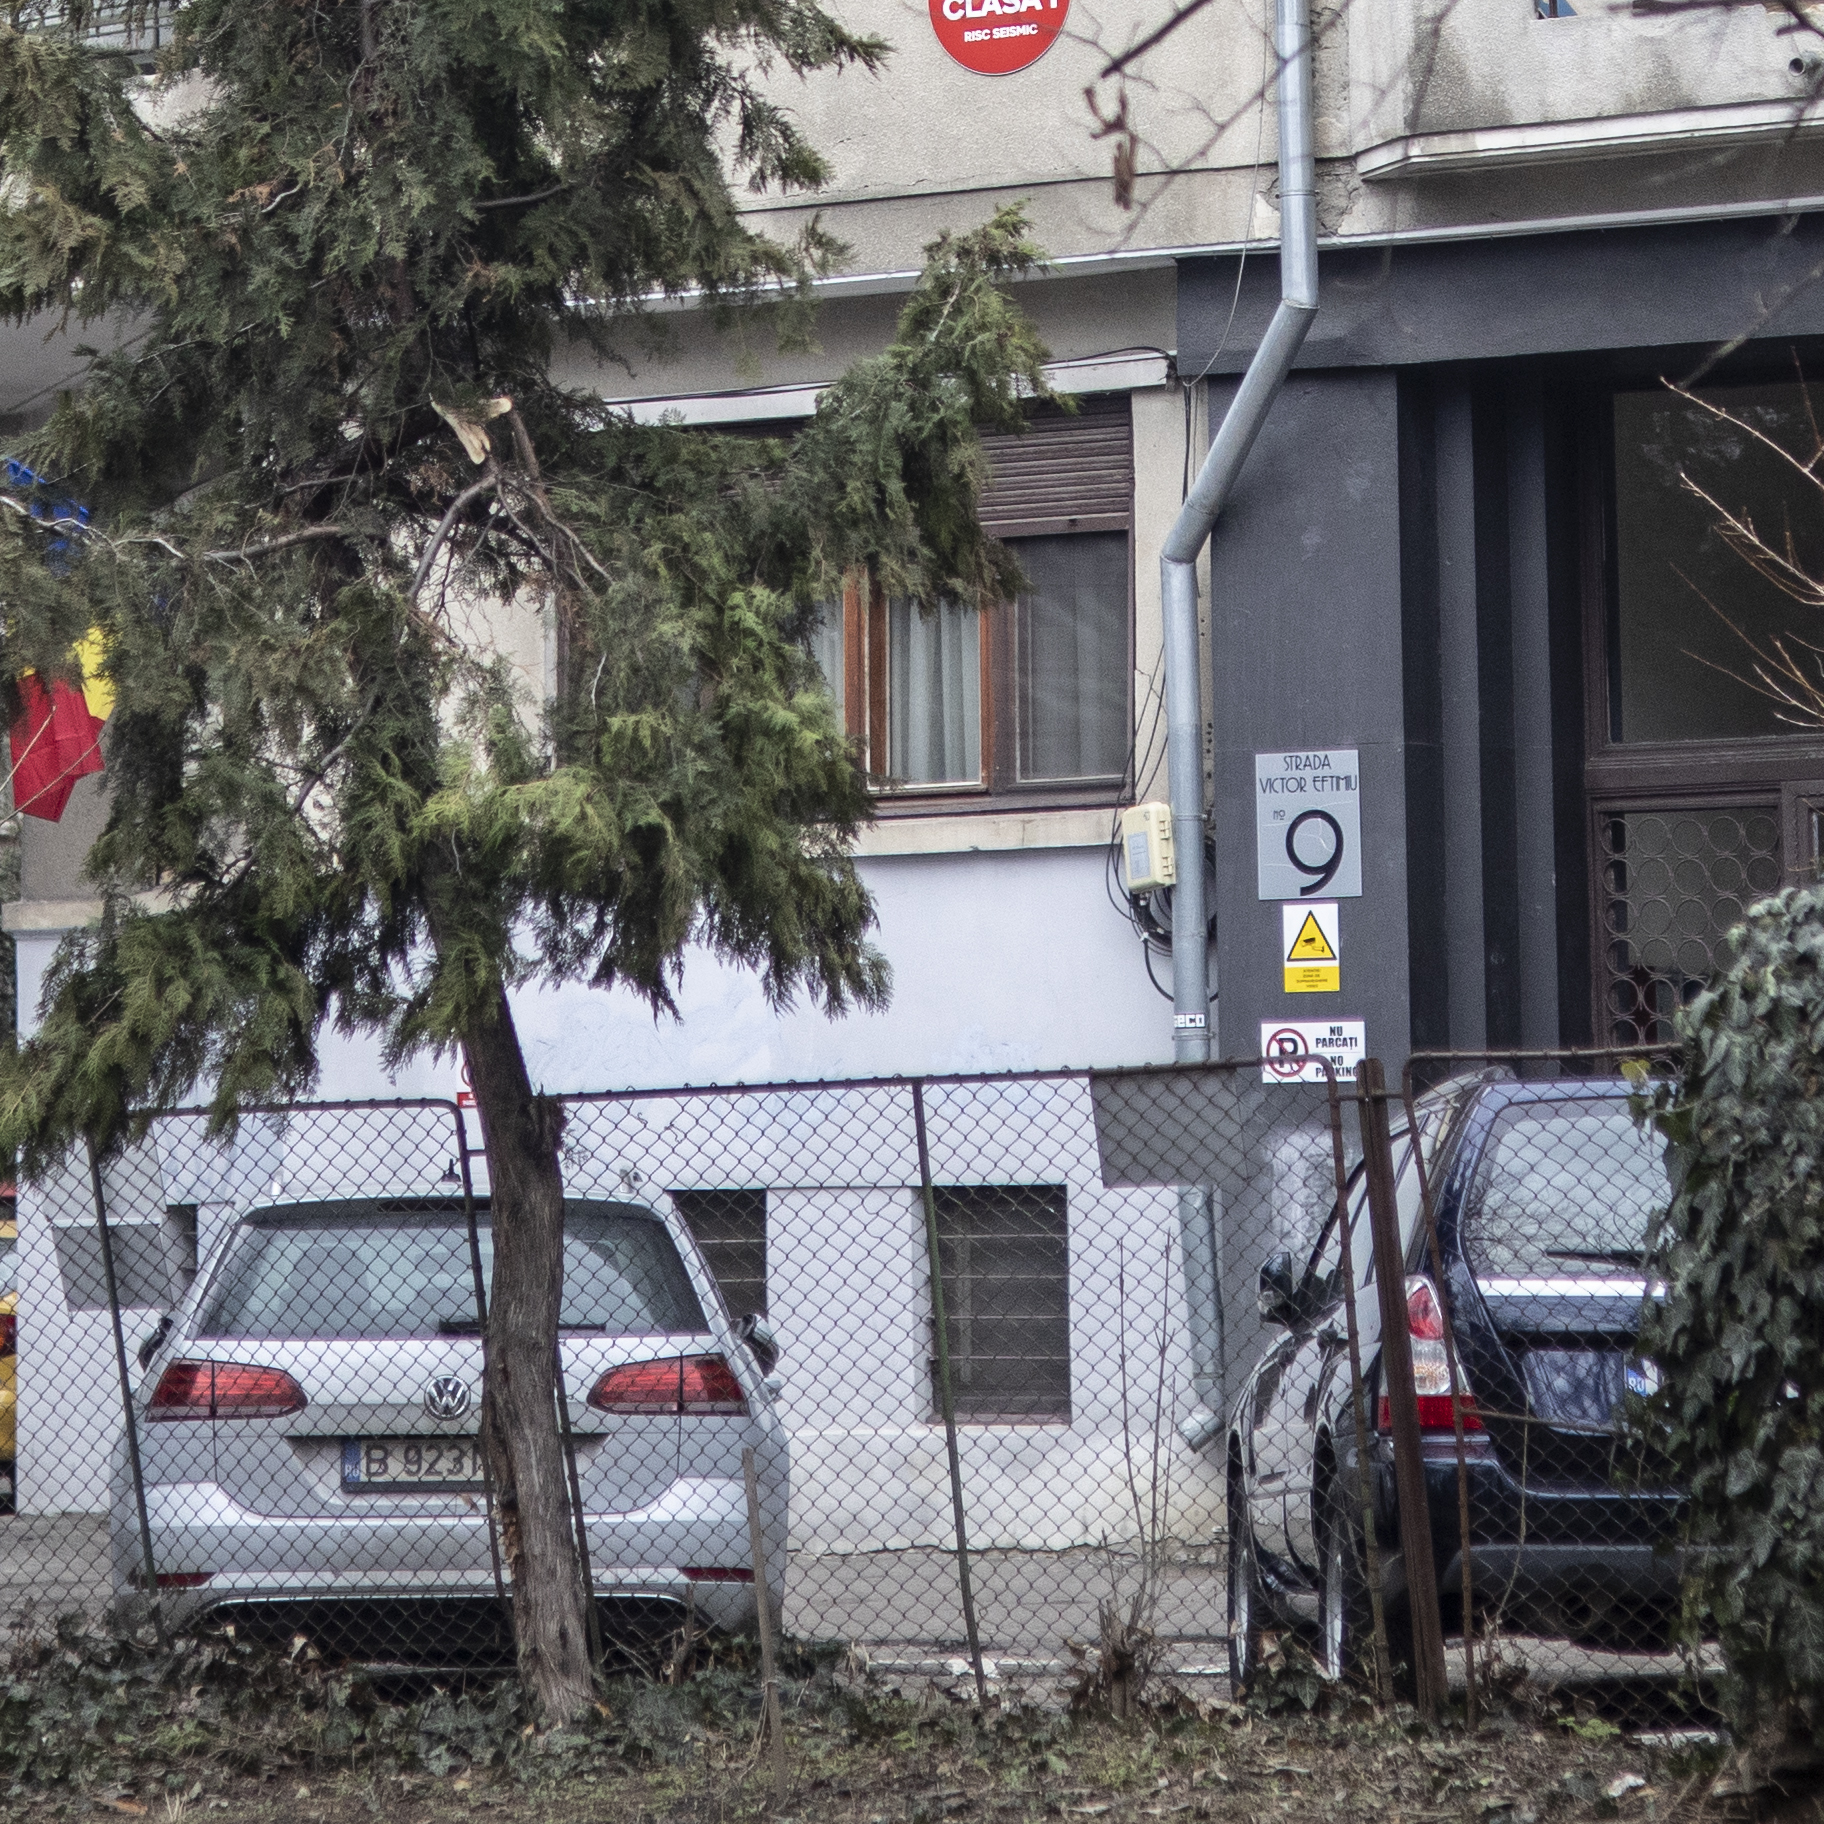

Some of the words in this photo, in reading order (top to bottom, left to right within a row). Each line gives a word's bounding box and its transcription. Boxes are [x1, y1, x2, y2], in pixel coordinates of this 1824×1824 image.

[964, 28, 991, 42] RISC
[992, 23, 1039, 39] SEISMIC
[1283, 754, 1332, 772] STRADA
[1259, 777, 1307, 794] VICTOR
[1312, 775, 1358, 792] EFTIMIU
[1285, 809, 1344, 897] 9
[1329, 1026, 1343, 1036] NU
[1315, 1037, 1358, 1050] PARCAȚI
[1330, 1056, 1344, 1066] NO
[365, 1444, 389, 1477] B
[403, 1444, 464, 1477] 923
